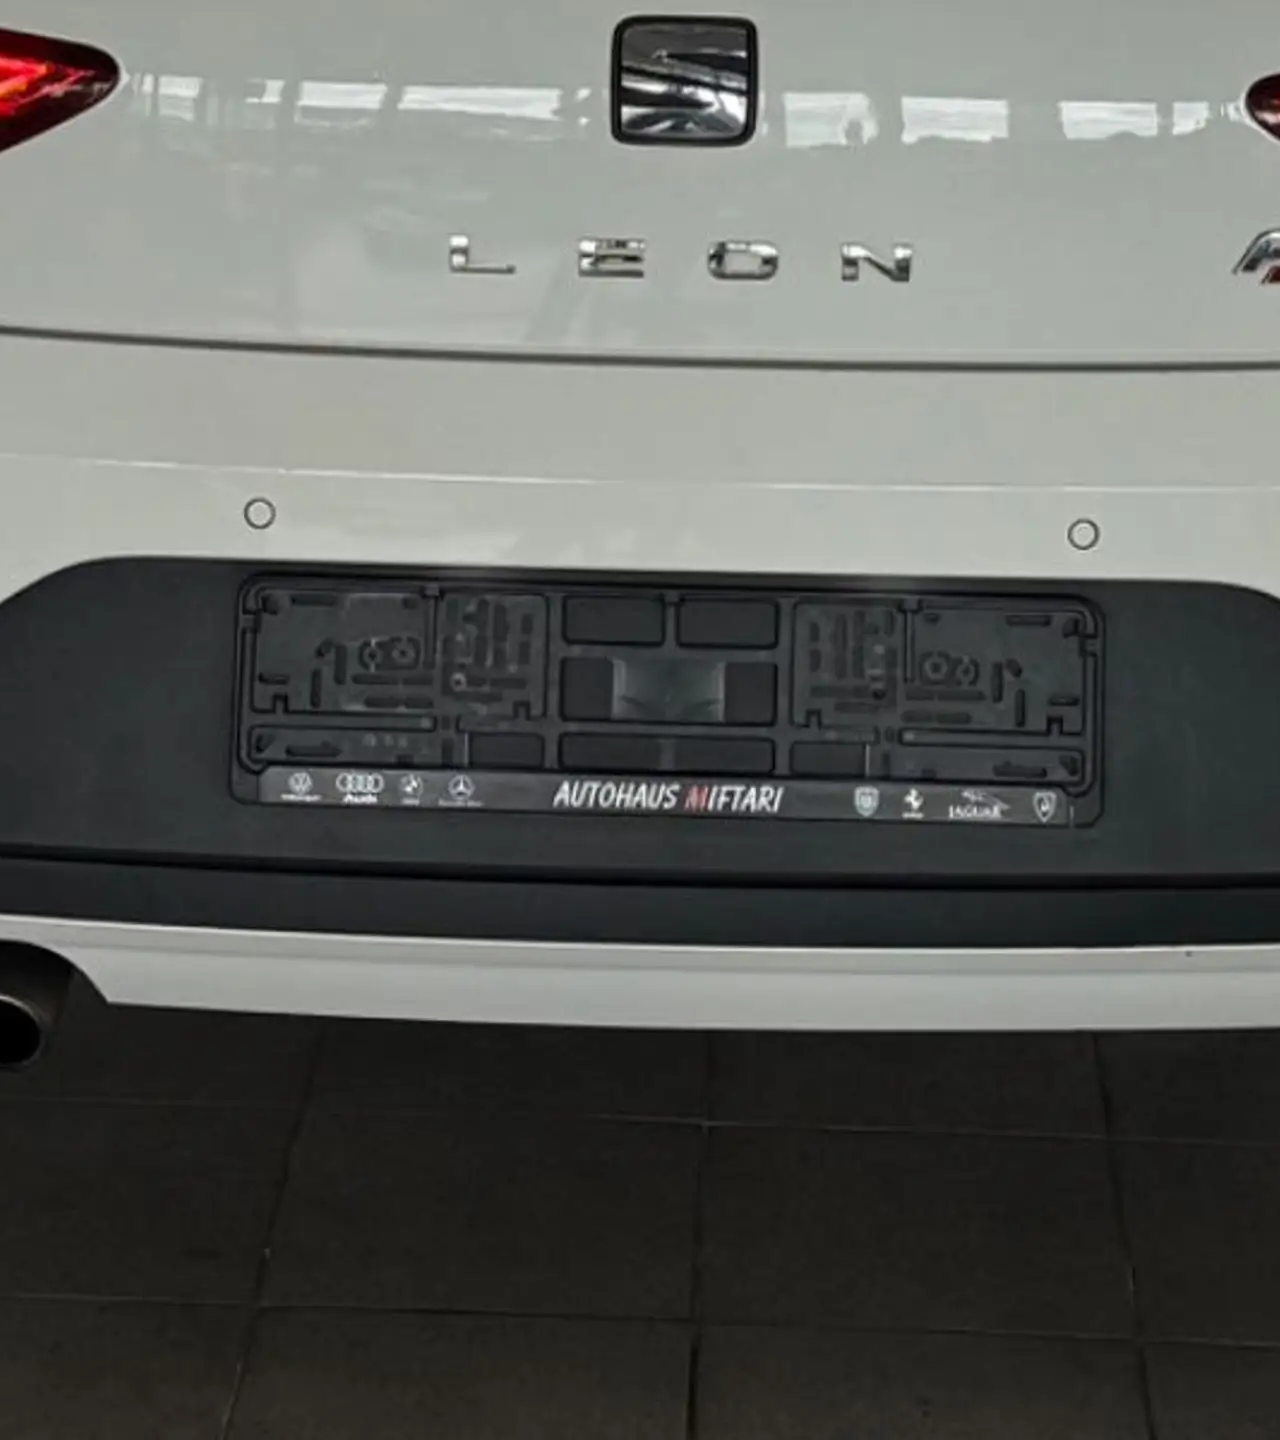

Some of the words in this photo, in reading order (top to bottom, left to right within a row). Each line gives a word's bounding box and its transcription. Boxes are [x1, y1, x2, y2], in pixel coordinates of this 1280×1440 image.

[448, 234, 914, 282] LEON
[552, 779, 681, 810] AUTOHAUS
[684, 783, 785, 814] MIFTARI
